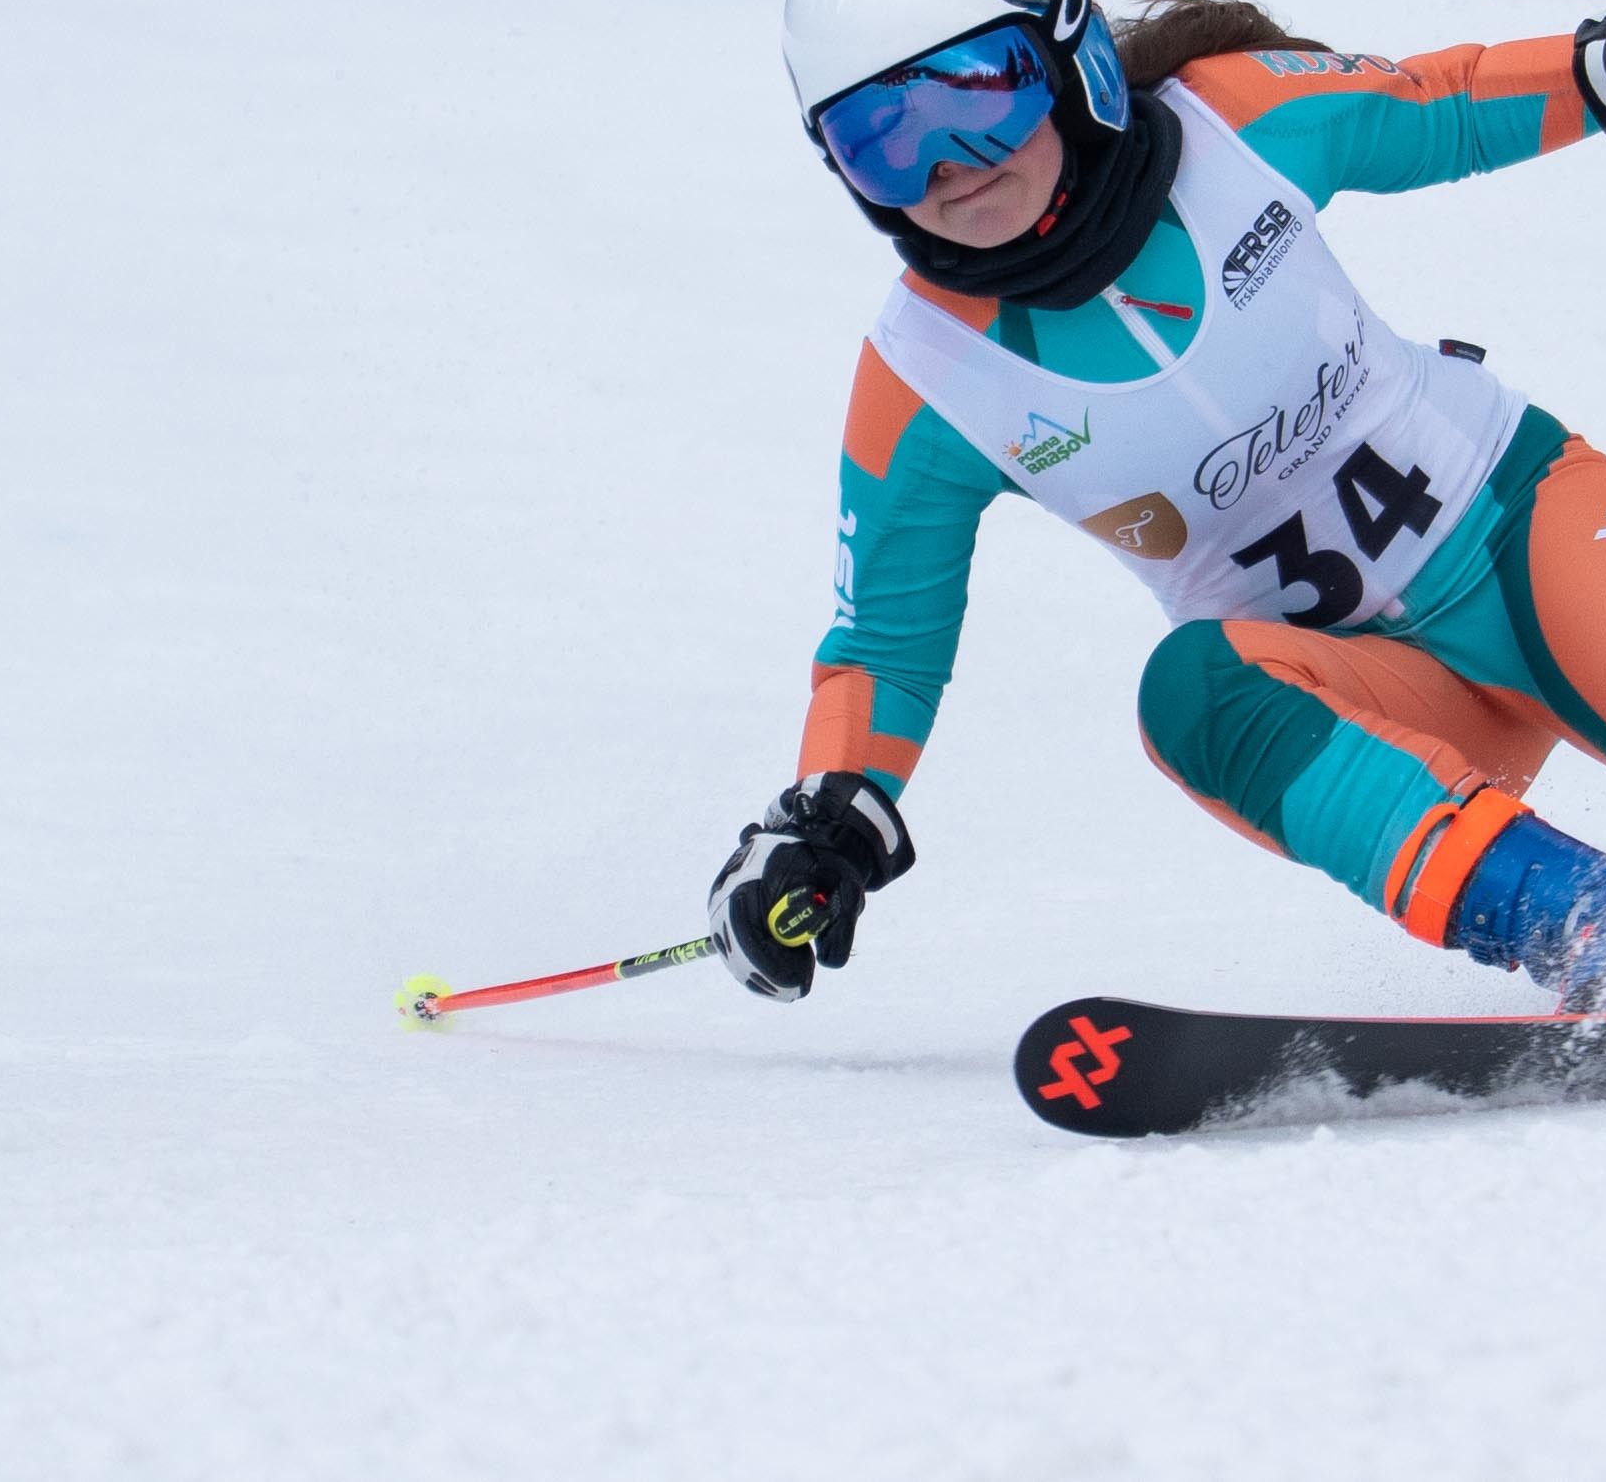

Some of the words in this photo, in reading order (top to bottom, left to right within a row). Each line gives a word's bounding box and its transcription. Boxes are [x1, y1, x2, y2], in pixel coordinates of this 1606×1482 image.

[1228, 200, 1293, 276] FRSB
[1233, 220, 1303, 312] frskibiathlon.ro
[1277, 424, 1332, 481] GRAND
[1334, 366, 1371, 422] HOTEL
[1230, 440, 1443, 629] 34
